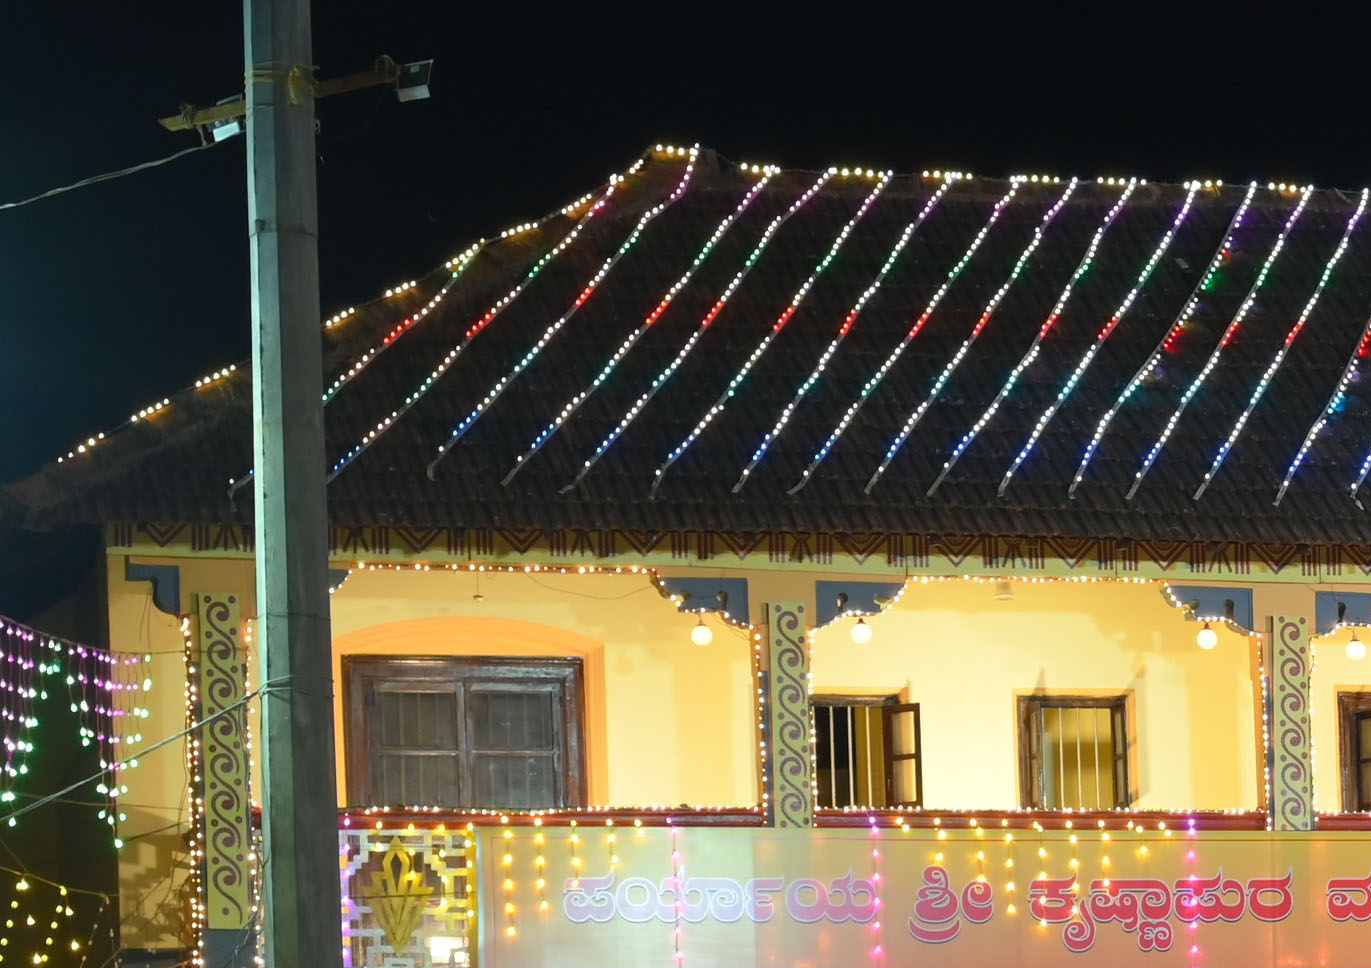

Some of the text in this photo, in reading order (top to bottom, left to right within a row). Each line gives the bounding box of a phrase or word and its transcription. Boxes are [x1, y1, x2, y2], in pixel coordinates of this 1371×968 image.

[563, 865, 879, 923] ಪರ್ಯಾಯ
[907, 864, 995, 943] ಶ್ರೀ
[1028, 866, 1294, 952] ಕೃಷ್ಣಾಪುರ
